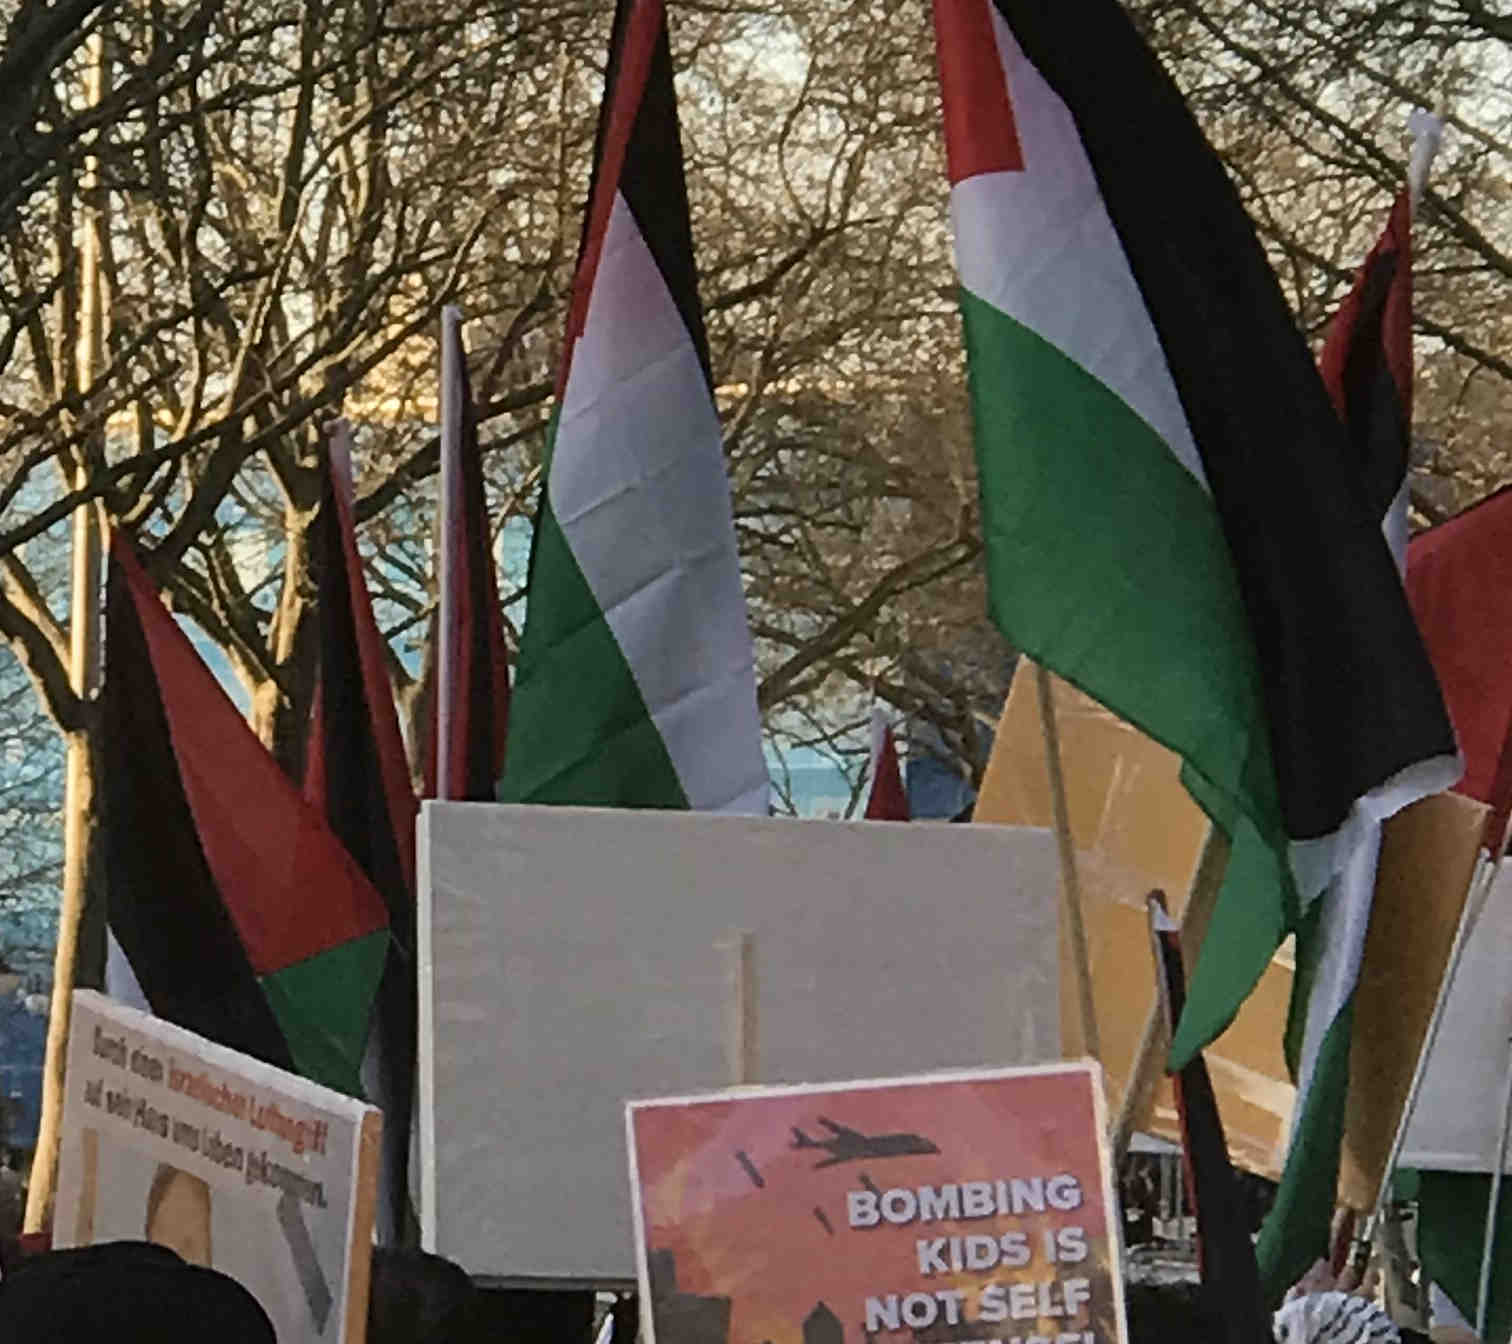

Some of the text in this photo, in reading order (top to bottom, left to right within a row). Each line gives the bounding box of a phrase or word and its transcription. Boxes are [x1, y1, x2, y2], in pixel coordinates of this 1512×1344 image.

[846, 1173, 1083, 1228] BOMBING
[916, 1226, 1087, 1275] KIDS IS
[865, 1279, 1091, 1333] NOT SELF
